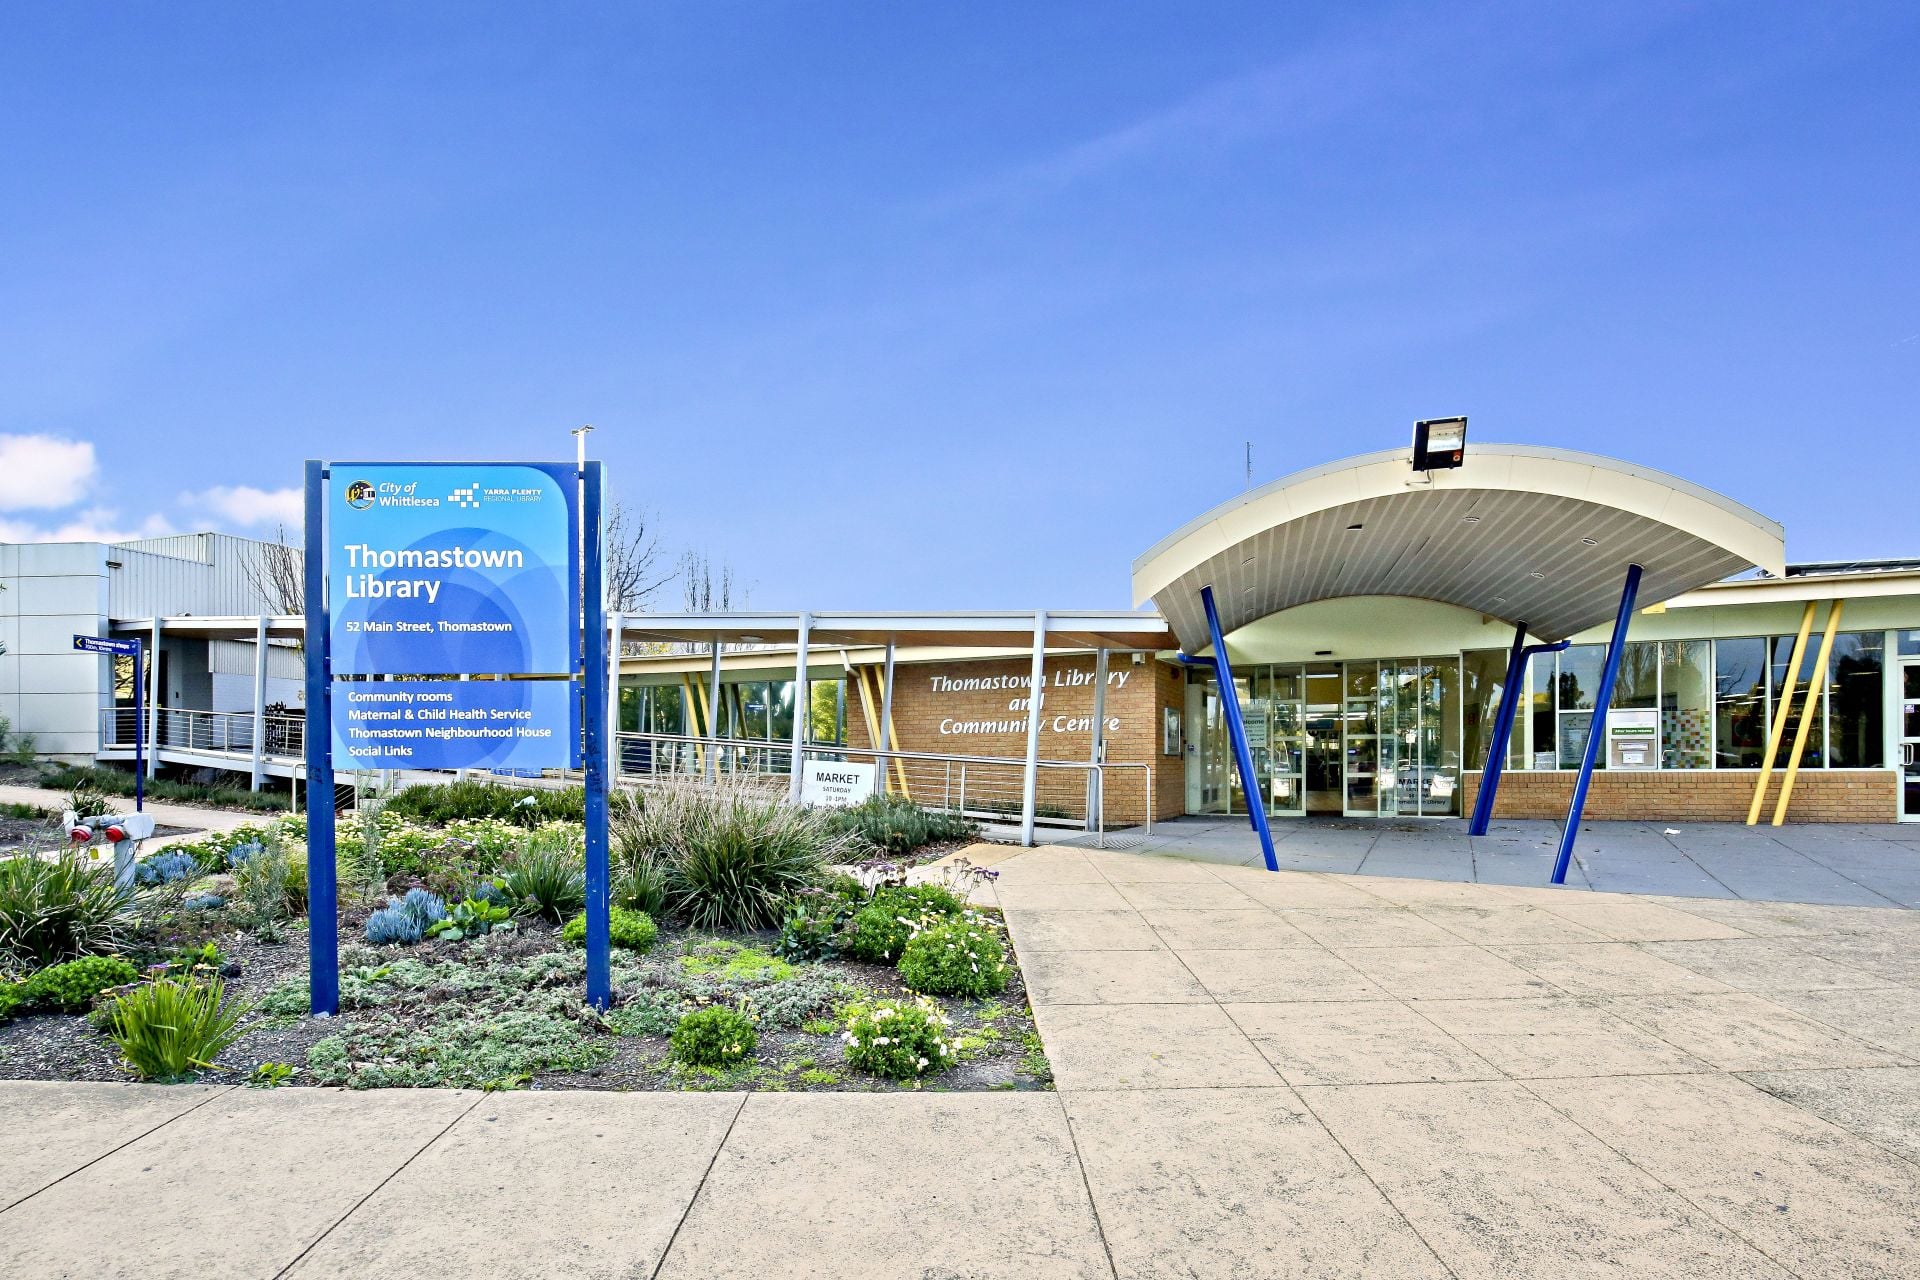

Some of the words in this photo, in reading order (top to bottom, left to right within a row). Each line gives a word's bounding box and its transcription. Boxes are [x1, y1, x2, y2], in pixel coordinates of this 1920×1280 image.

[379, 482, 401, 495] City
[404, 482, 417, 494] of
[379, 495, 440, 507] Whittlesea
[344, 543, 523, 568] Thomastown
[346, 574, 441, 604] Library
[346, 622, 360, 632] 52
[363, 622, 393, 632] Main
[396, 622, 434, 634] Street,
[437, 621, 513, 632] Thomastown
[1054, 669, 1131, 689] Librry
[348, 691, 414, 704] Community
[417, 693, 453, 702] rooms
[348, 709, 401, 720] Maternal
[404, 709, 415, 720] &
[417, 709, 446, 720] Child
[449, 709, 488, 720] Health
[490, 709, 532, 720] Service
[940, 716, 1047, 735] Communiy
[349, 728, 423, 739] Thomastown
[425, 727, 513, 740] Neighbourhood
[516, 727, 552, 738] House
[348, 745, 381, 756] Social
[384, 745, 413, 756] Links
[816, 772, 860, 785] MARKET
